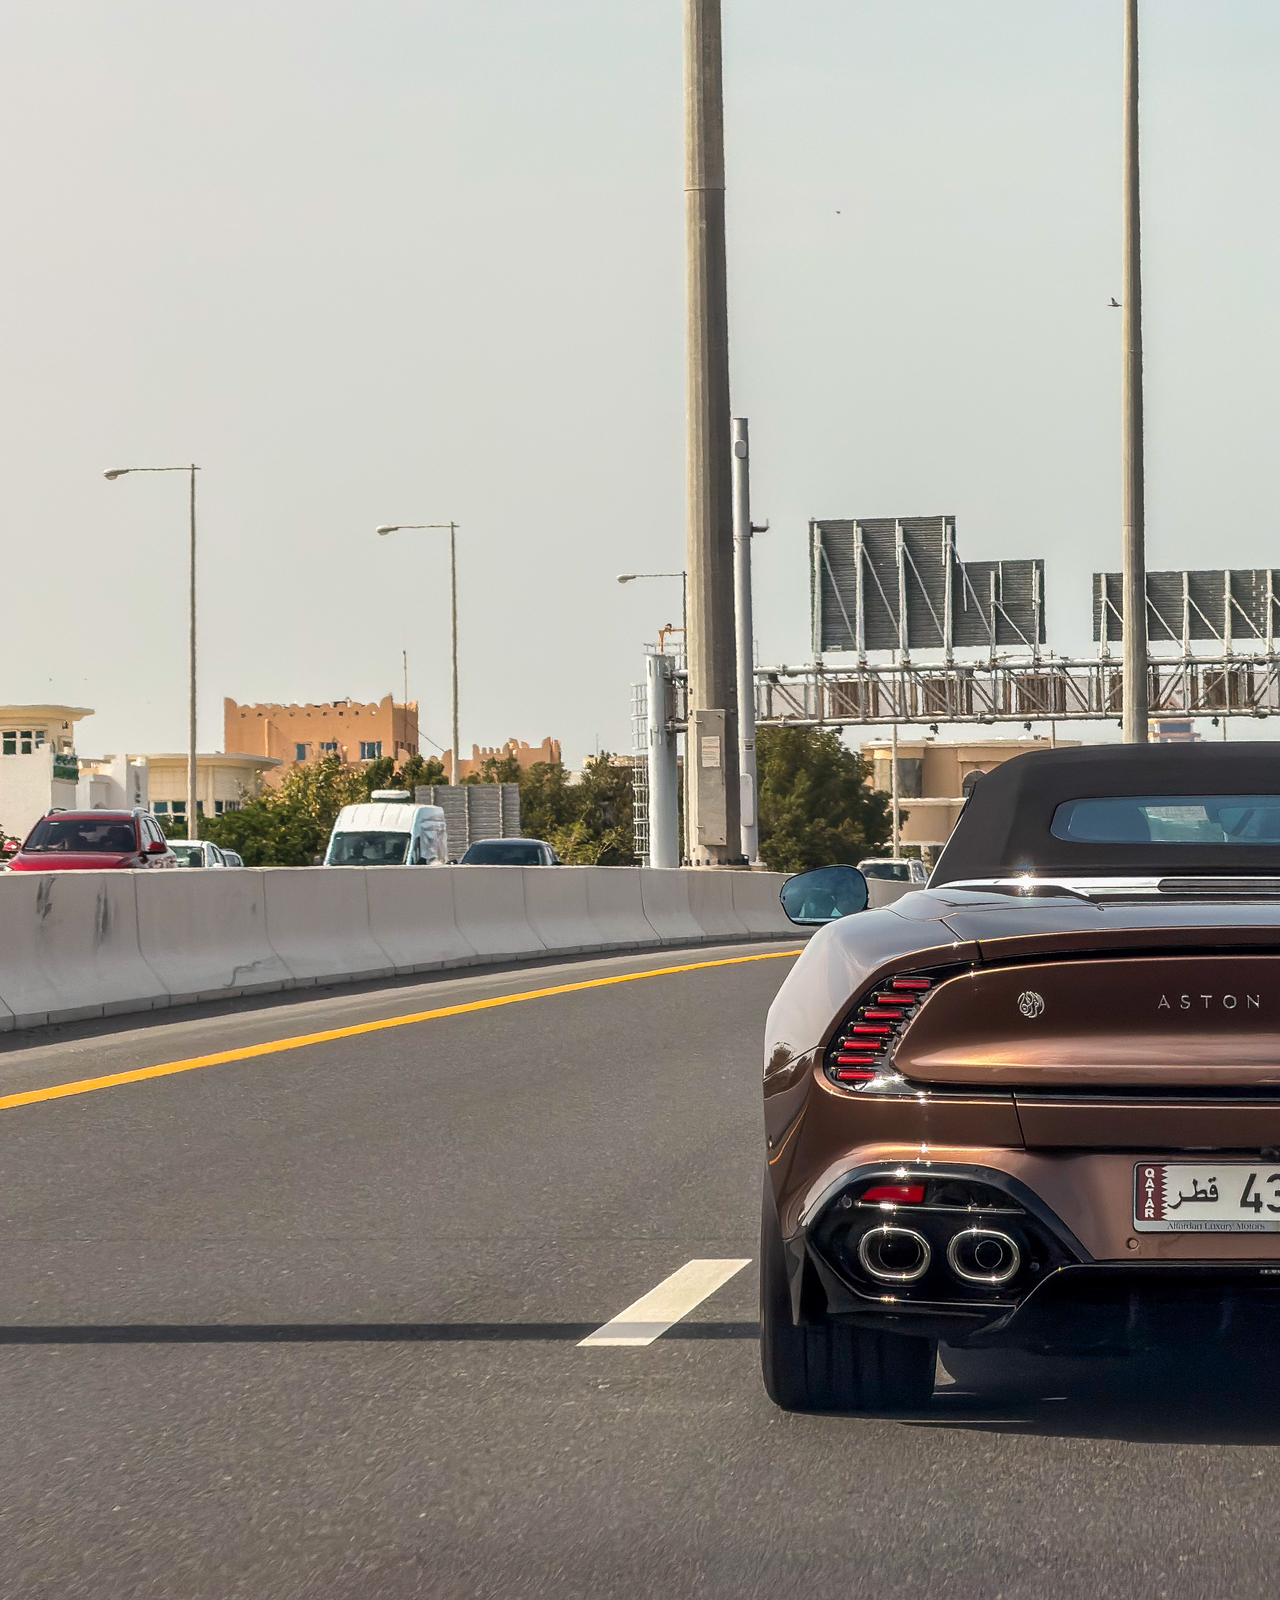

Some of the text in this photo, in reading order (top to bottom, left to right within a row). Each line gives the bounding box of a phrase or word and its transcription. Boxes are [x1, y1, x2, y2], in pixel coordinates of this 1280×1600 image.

[1157, 994, 1261, 1010] ASTON
[1143, 1167, 1156, 1218] QATAR
[1167, 1176, 1219, 1210] قطر
[1204, 1222, 1232, 1231] Luxury
